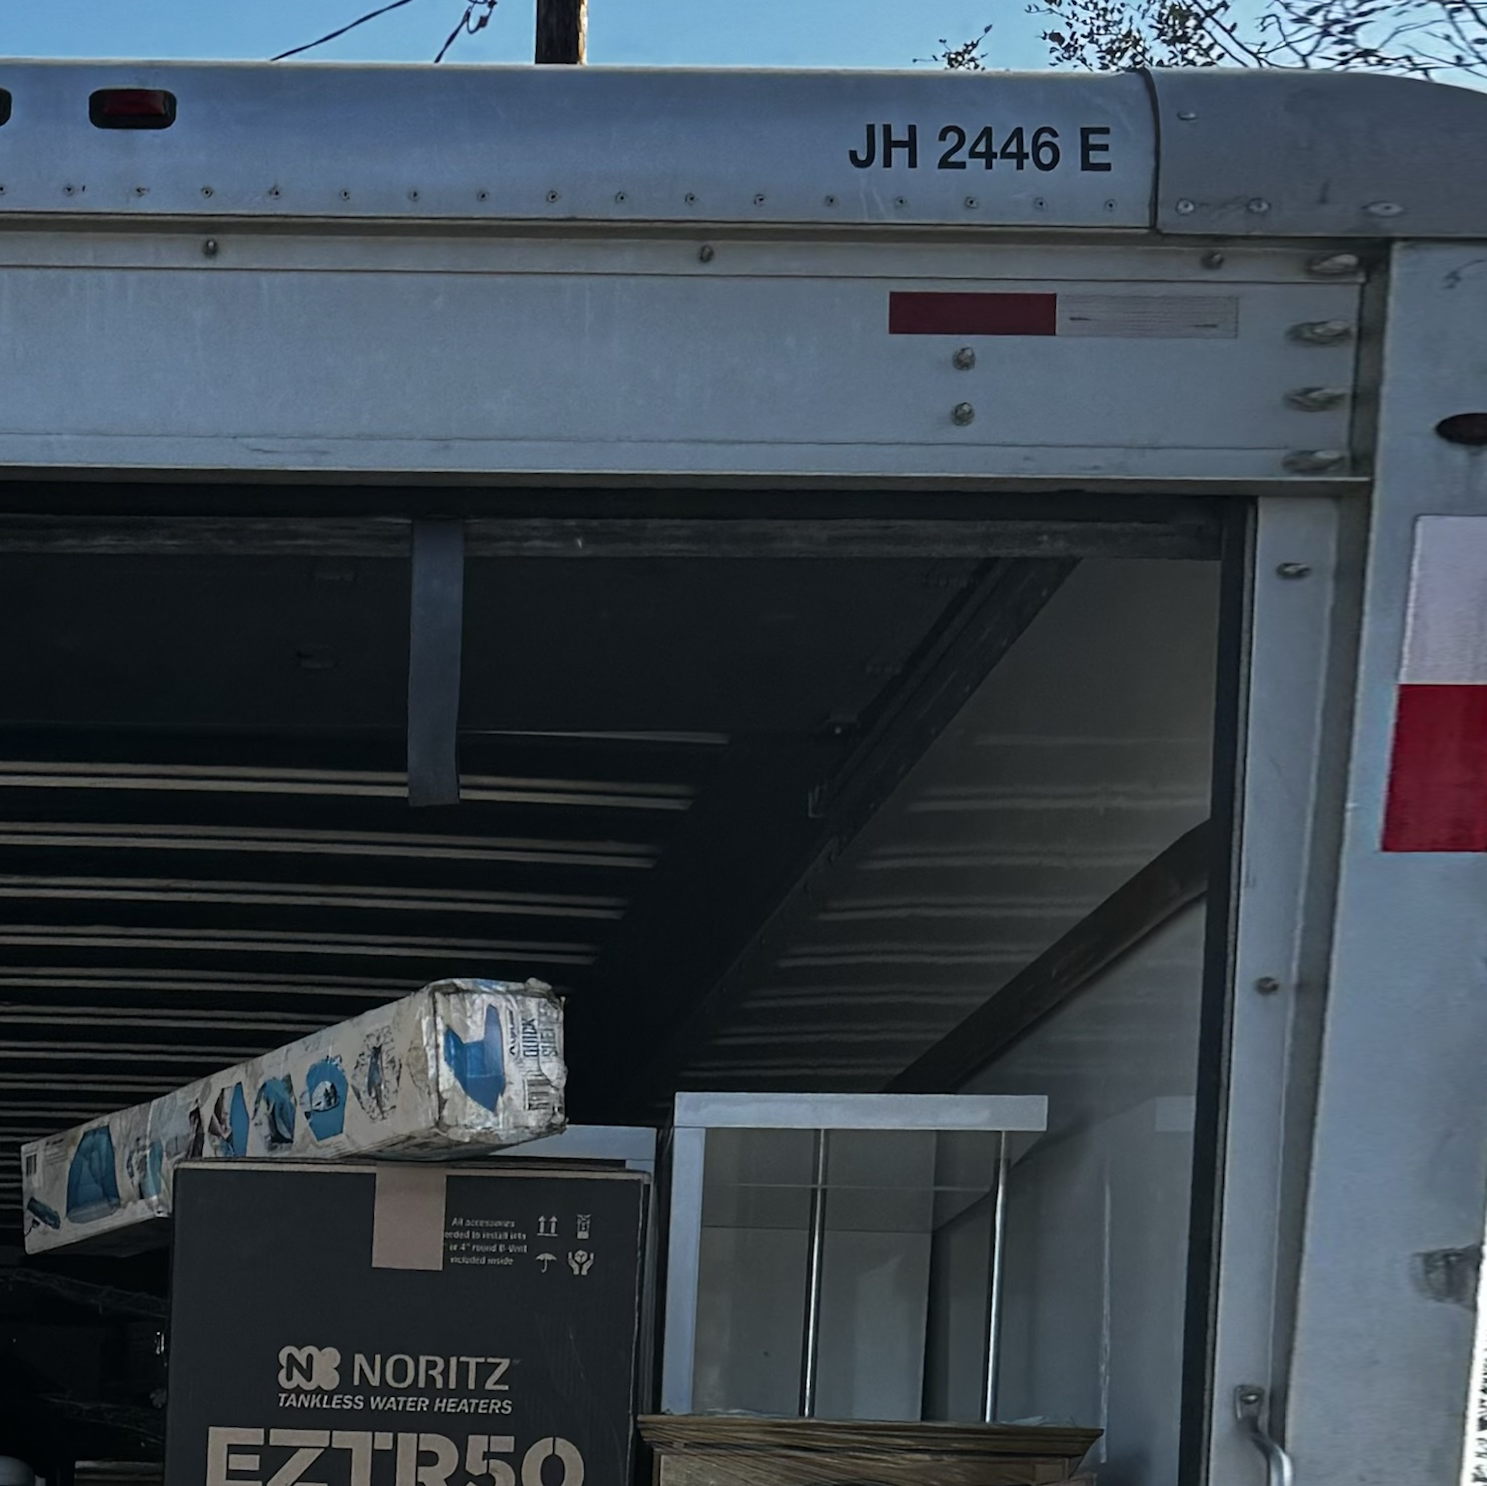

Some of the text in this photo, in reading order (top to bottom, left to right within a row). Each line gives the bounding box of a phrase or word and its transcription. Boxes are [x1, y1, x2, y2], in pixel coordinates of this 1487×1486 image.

[848, 123, 1112, 172] JH 2446 E
[522, 1017, 539, 1058] QUICK
[444, 1230, 470, 1239] eeded
[352, 1352, 511, 1391] NORITZ
[277, 1392, 514, 1415] TANKLESS WATER HEATERS
